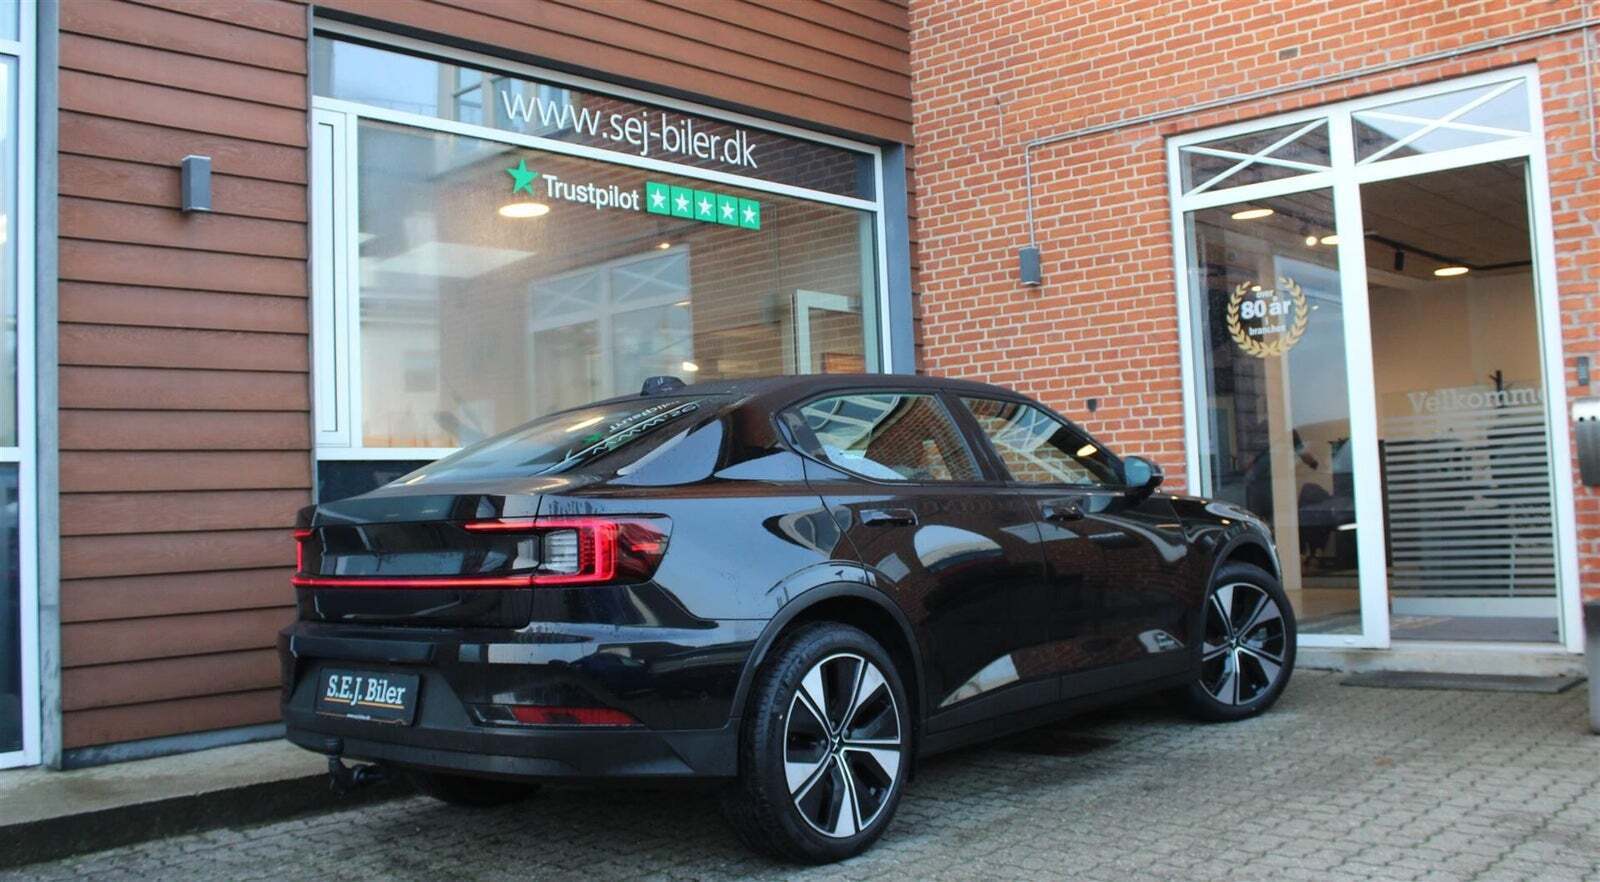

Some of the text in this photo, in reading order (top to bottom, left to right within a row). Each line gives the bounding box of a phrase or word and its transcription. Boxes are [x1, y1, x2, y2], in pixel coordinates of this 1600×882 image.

[502, 90, 758, 169] www.sej-biler.dk
[542, 174, 640, 211] Trustpilot
[1241, 296, 1292, 320] 80 år
[327, 674, 406, 706] S.E.J. Biler
